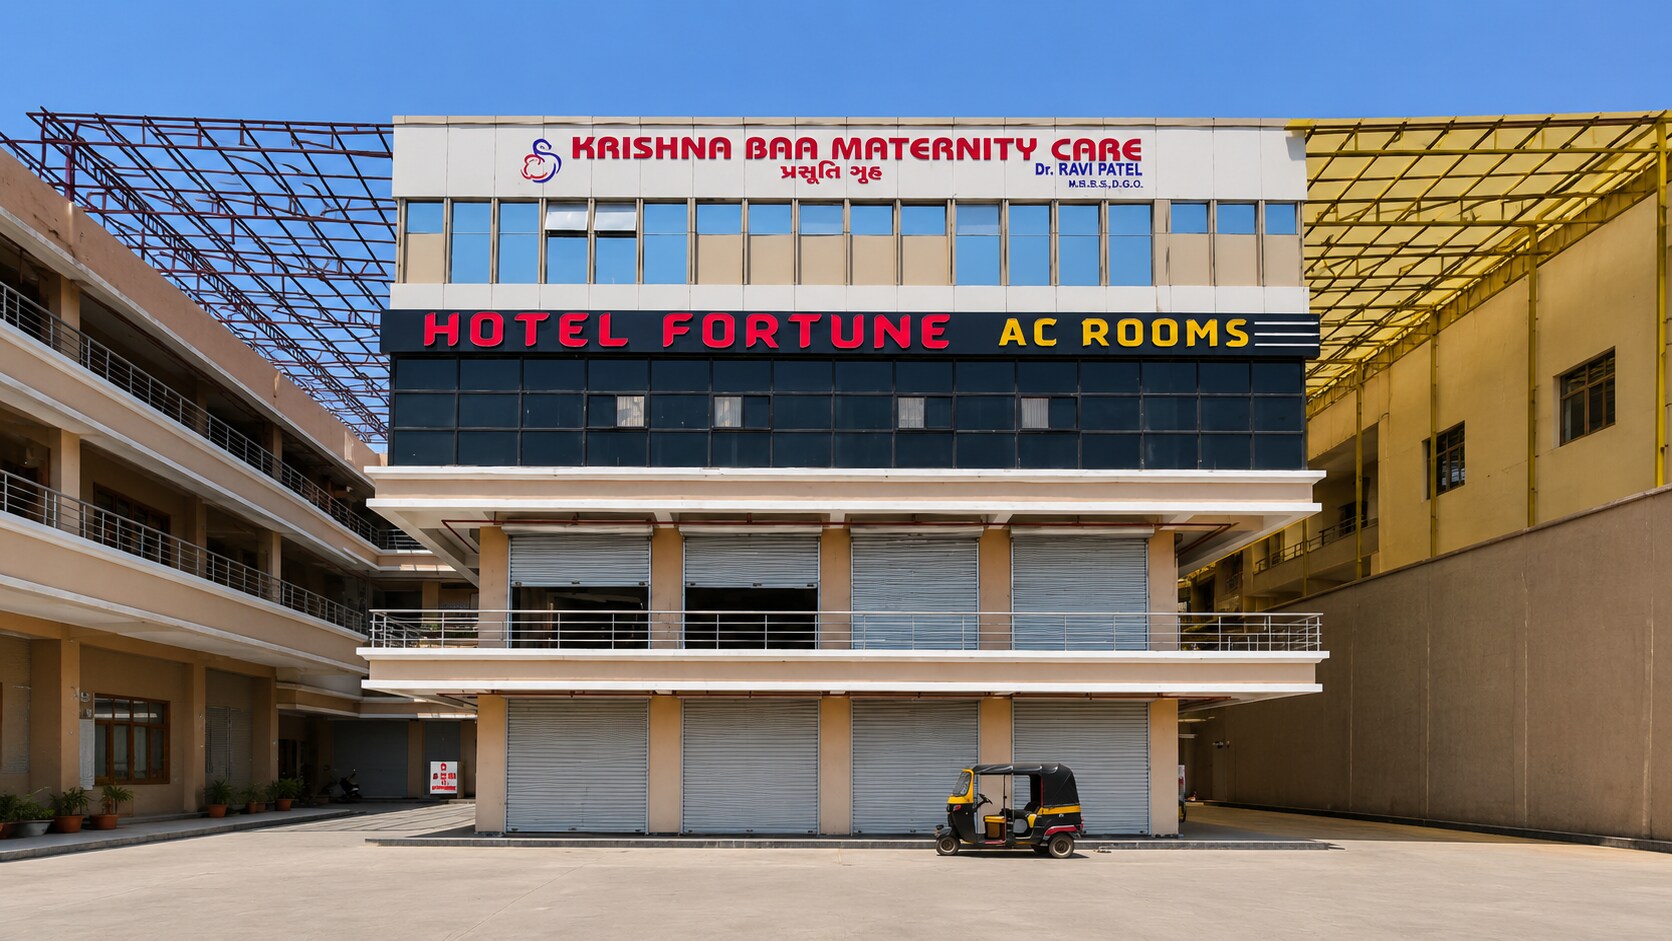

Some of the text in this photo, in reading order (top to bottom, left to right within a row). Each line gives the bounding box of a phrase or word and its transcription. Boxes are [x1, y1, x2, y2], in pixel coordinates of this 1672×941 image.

[572, 136, 1142, 161] KRISHNA BAA MATERNITY CARE
[780, 160, 841, 184] પ્રસૂતિ
[1035, 162, 1143, 176] Dr. RAVI PATEL
[423, 312, 951, 349] HOTEL FORTUNE
[998, 318, 1250, 348] AC ROOMS
